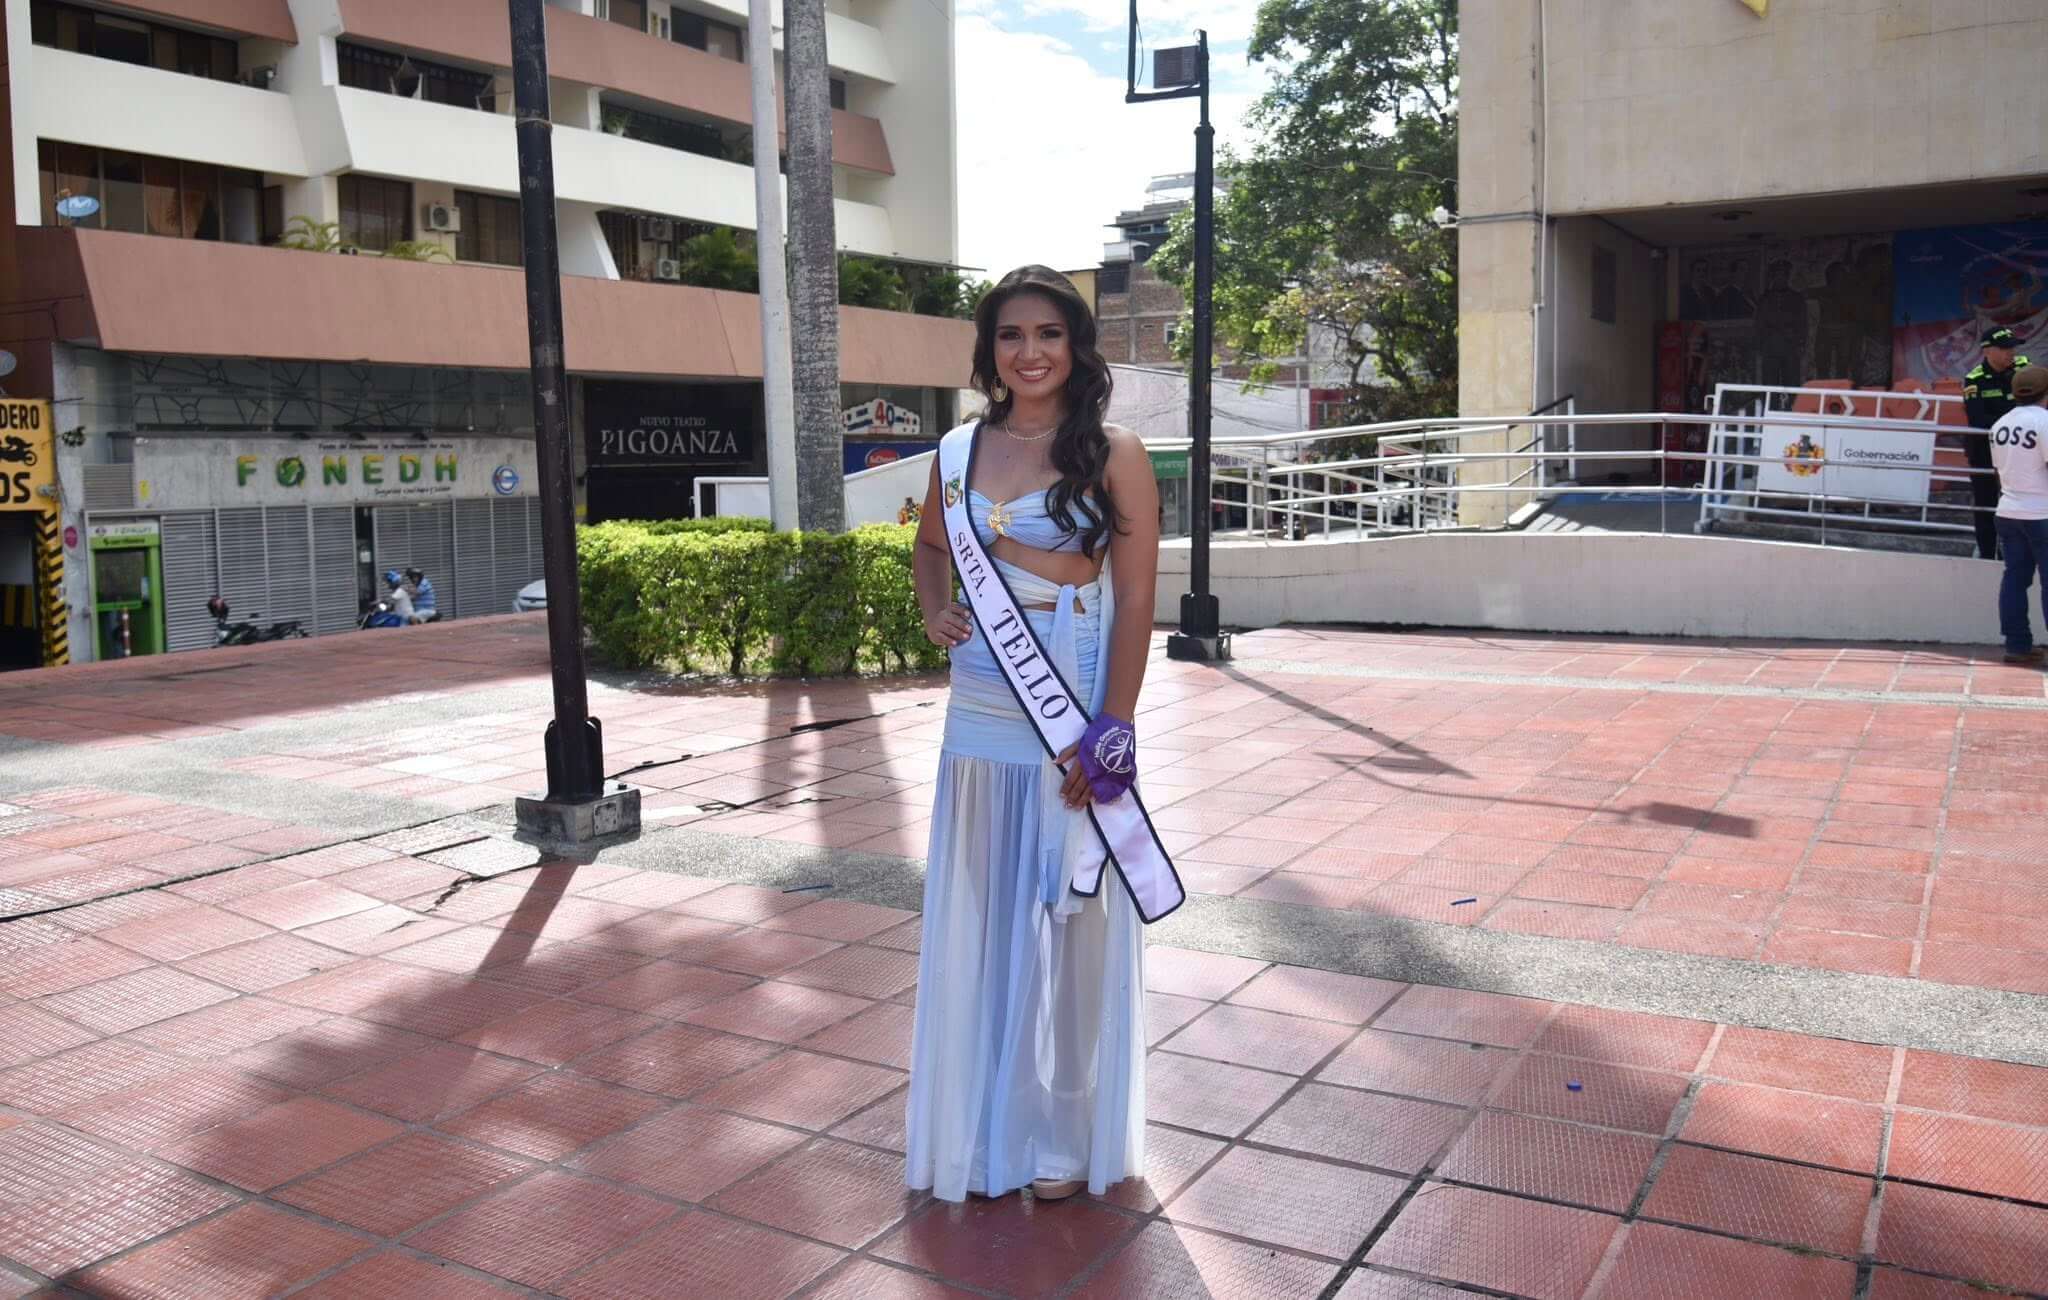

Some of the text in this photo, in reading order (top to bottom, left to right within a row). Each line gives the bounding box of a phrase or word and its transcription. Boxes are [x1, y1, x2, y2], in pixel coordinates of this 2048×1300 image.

[639, 416, 706, 427] NUEVO TEATRO
[600, 429, 739, 455] PIGOANZA
[1843, 448, 1920, 462] Gobernación
[236, 453, 459, 487] FONEDH
[953, 531, 1070, 720] SRTA. TELLO
